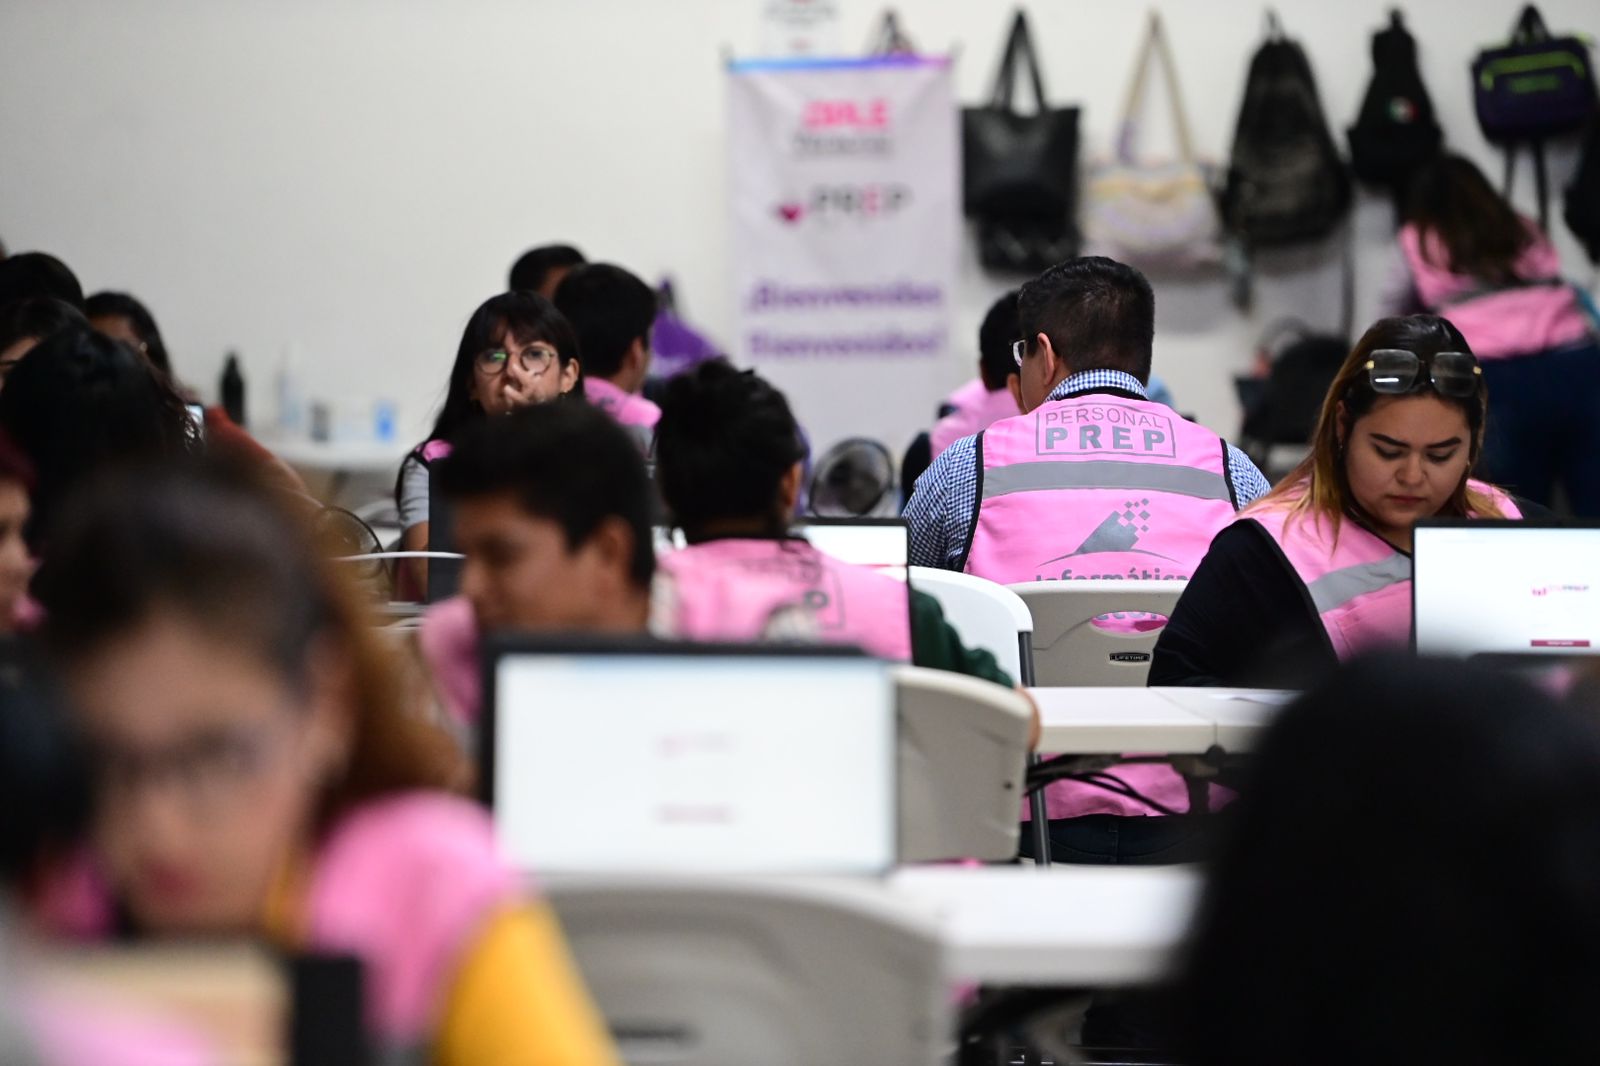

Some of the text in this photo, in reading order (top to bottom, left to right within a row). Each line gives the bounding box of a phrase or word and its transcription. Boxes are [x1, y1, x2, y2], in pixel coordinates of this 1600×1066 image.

[1044, 407, 1164, 429] PERSONAL
[1044, 424, 1166, 451] PREP
[1035, 567, 1190, 581] formáti
